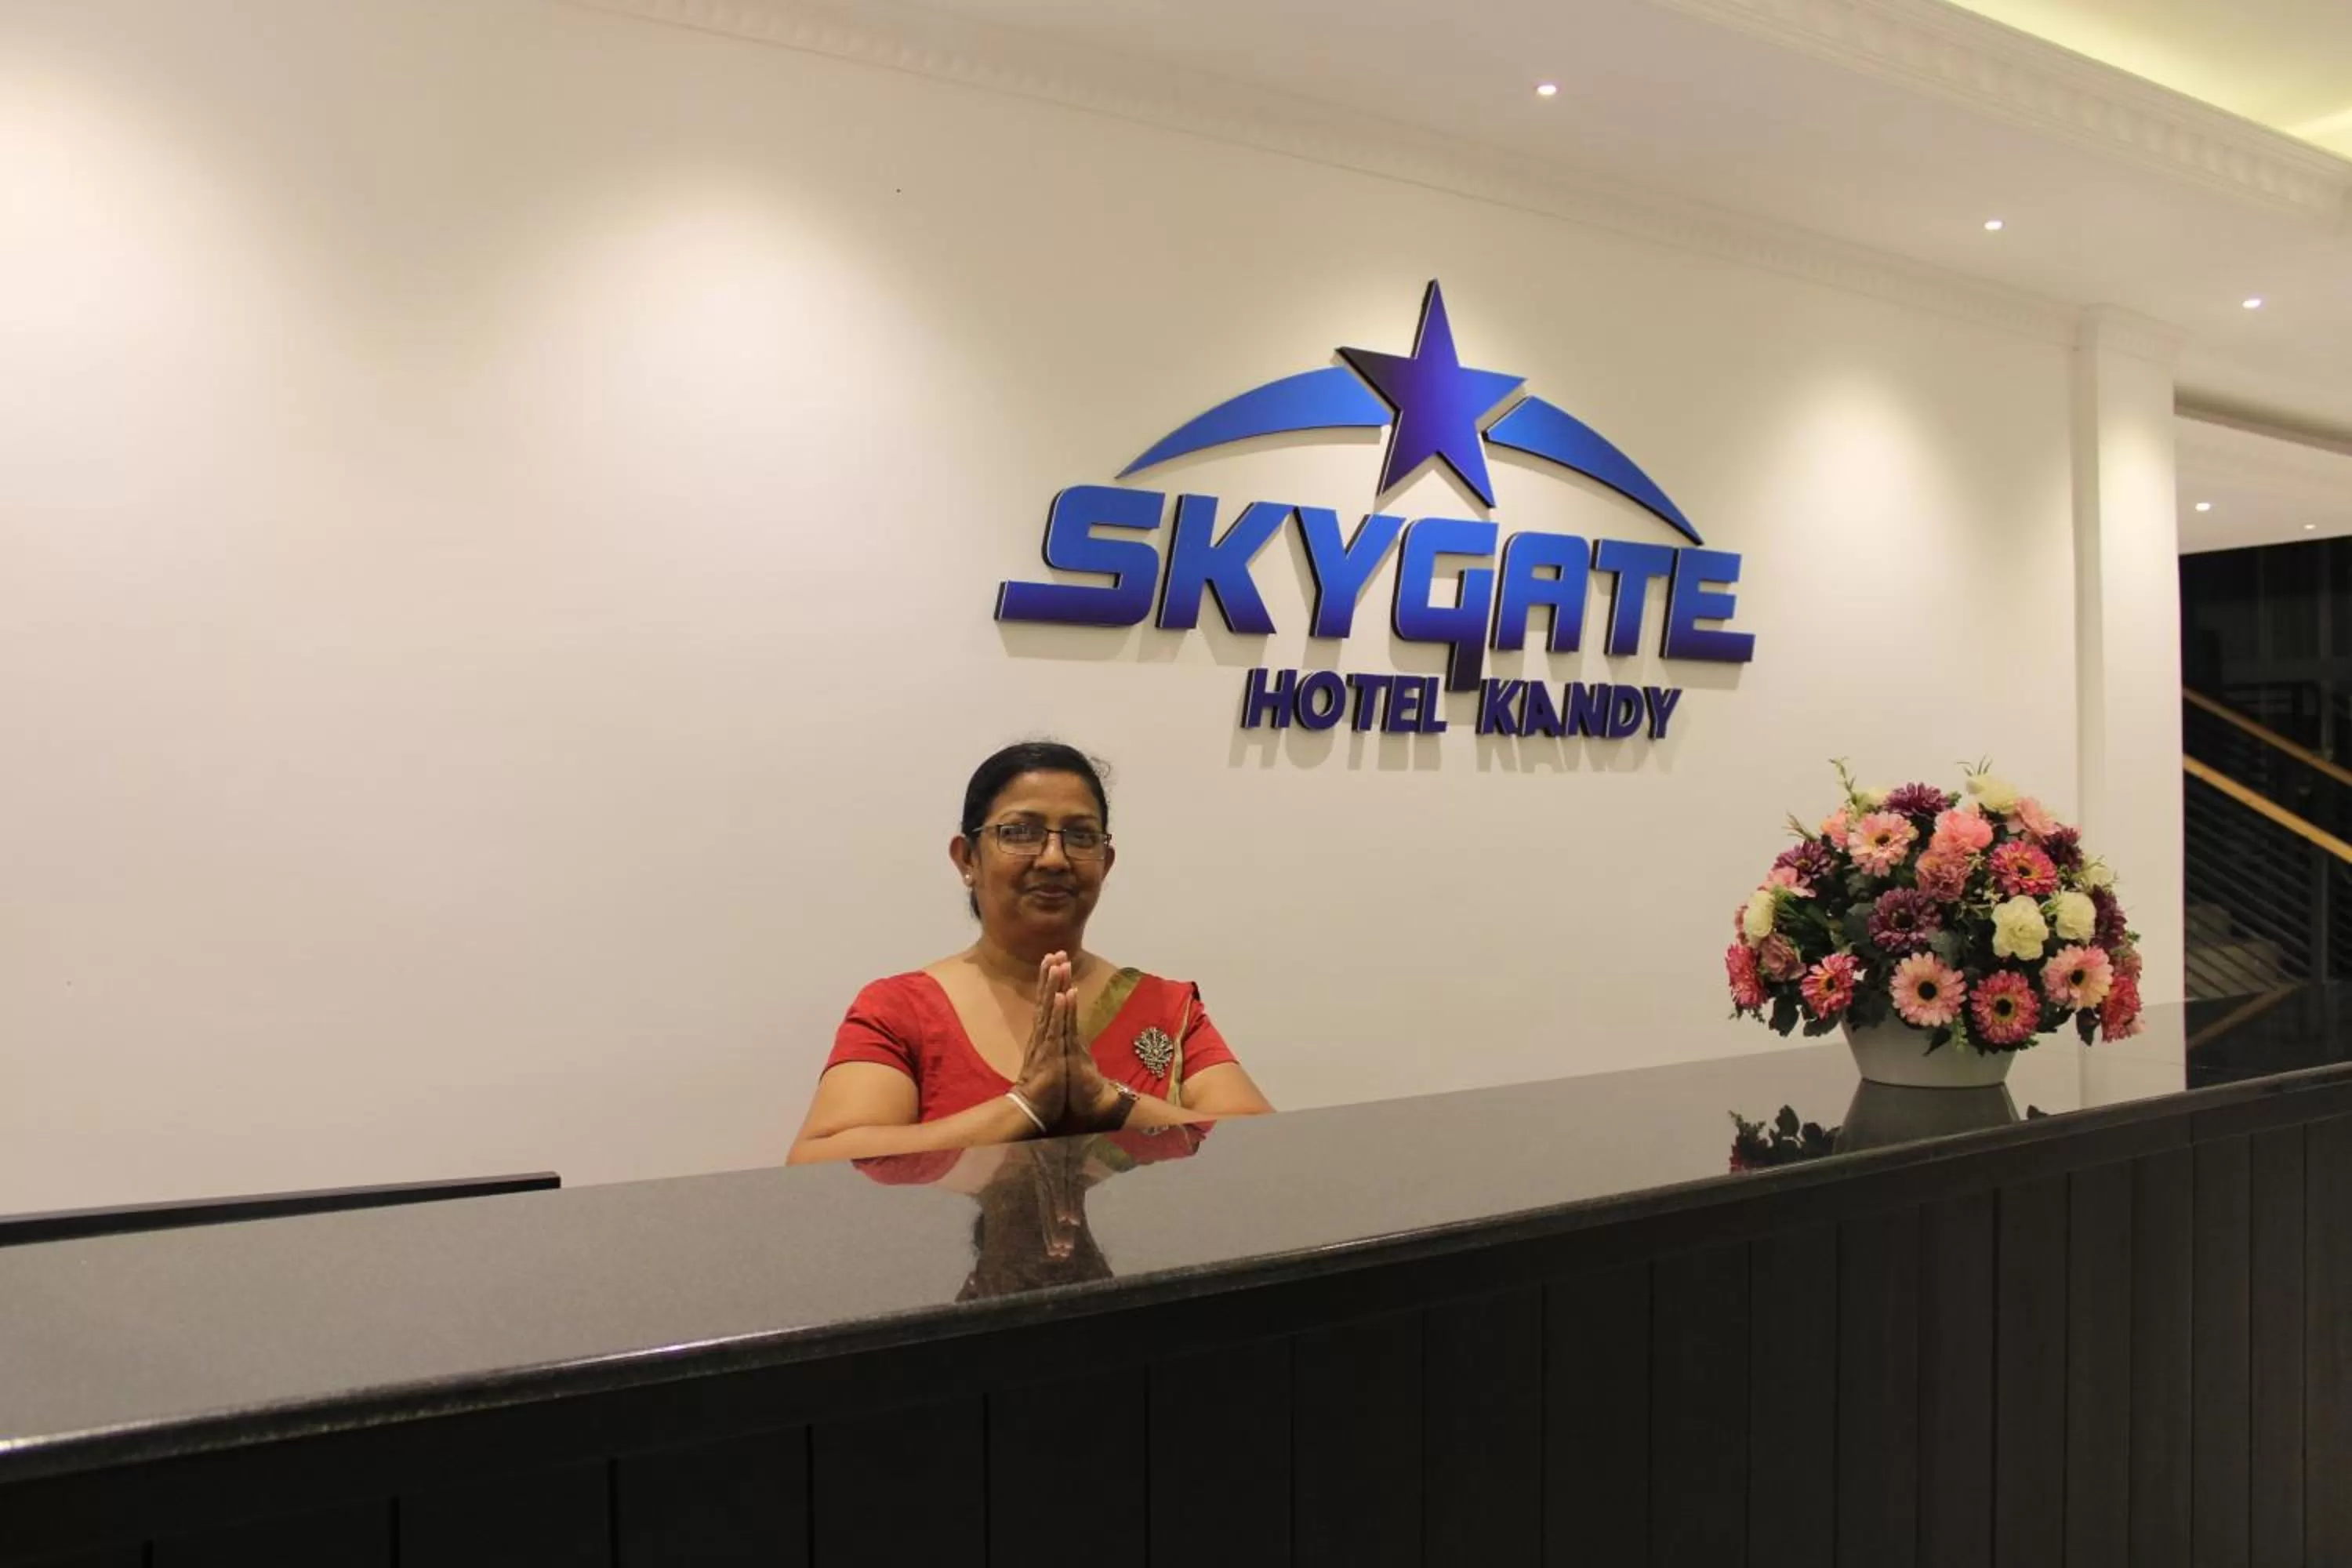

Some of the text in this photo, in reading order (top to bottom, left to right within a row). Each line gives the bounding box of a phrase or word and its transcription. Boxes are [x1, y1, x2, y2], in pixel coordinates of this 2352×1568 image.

[995, 485, 1755, 691] SKYGATE
[1241, 668, 1682, 740] HOTEL KANDY
